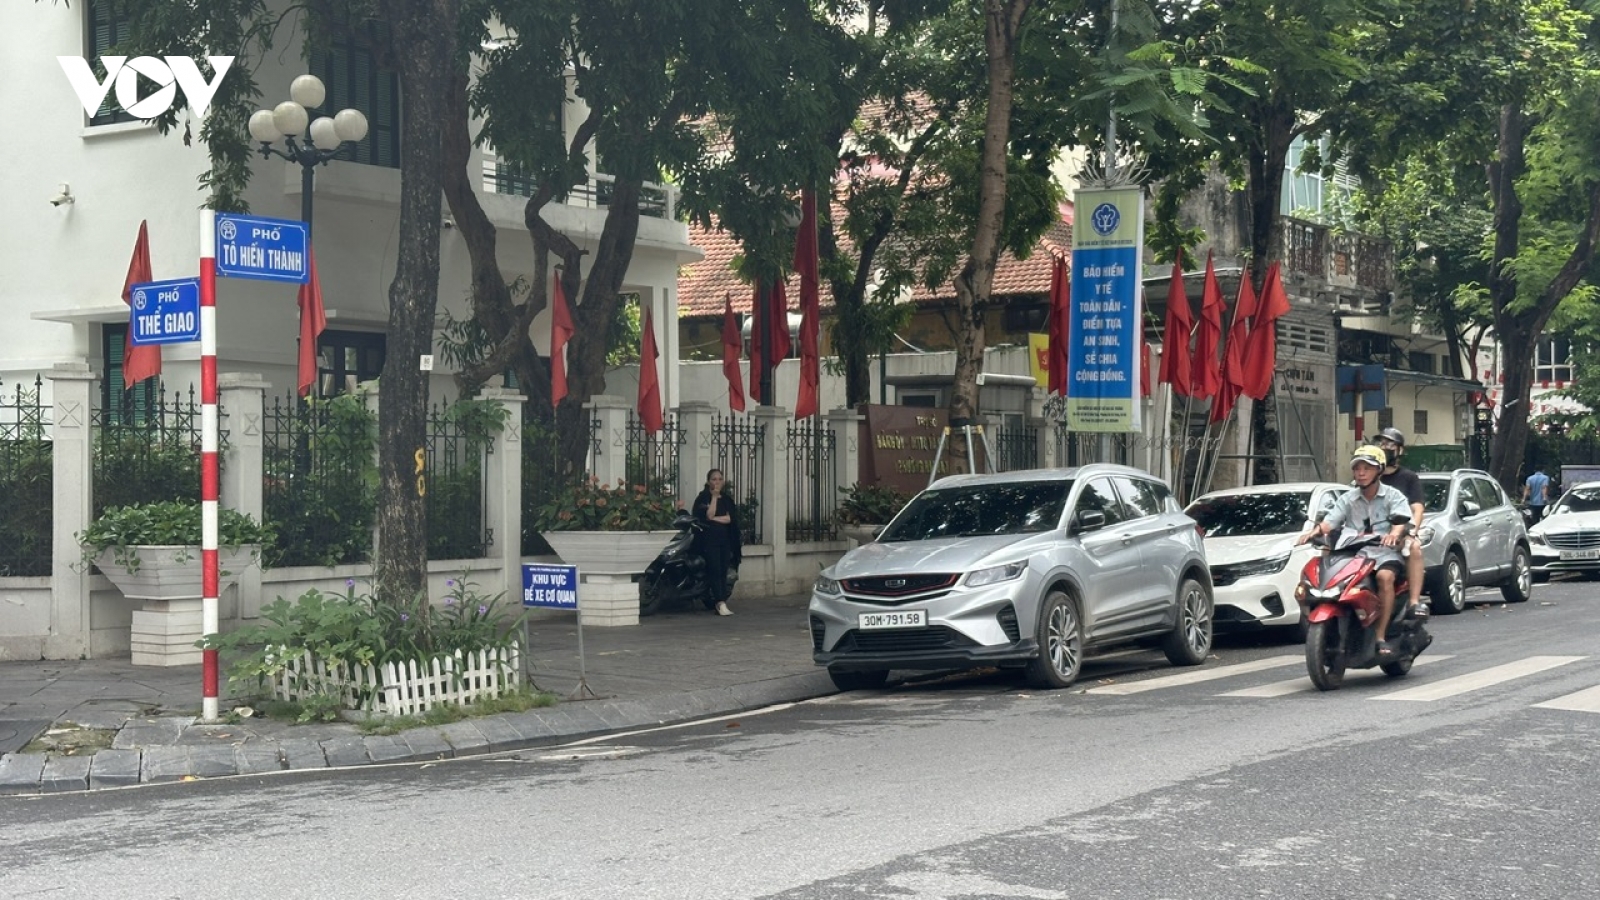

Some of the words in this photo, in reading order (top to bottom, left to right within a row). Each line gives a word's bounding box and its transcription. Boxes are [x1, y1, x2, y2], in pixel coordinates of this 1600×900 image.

[252, 227, 281, 241] PHỐ
[223, 242, 237, 265] TÔ
[240, 241, 264, 268] HIẾN
[268, 246, 302, 272] THÀNH
[1083, 264, 1101, 278] BẢO
[158, 286, 179, 303] PHỐ
[1095, 284, 1101, 295] Y
[1102, 280, 1113, 295] TẾ
[1079, 299, 1102, 313] TOÀN
[1103, 298, 1121, 312] DÂN
[138, 305, 161, 336] THỂ
[164, 311, 195, 334] GIAO
[1105, 318, 1122, 331] TỰA
[1083, 335, 1096, 347] AN
[1098, 354, 1118, 365] CHIA
[1075, 368, 1099, 384] CỘNG
[532, 573, 549, 585] KHU
[550, 573, 567, 587] VỰC
[524, 583, 535, 601] ĐỂ
[535, 588, 545, 602] XE
[545, 587, 556, 602] CƠ
[556, 589, 576, 604] QUAN
